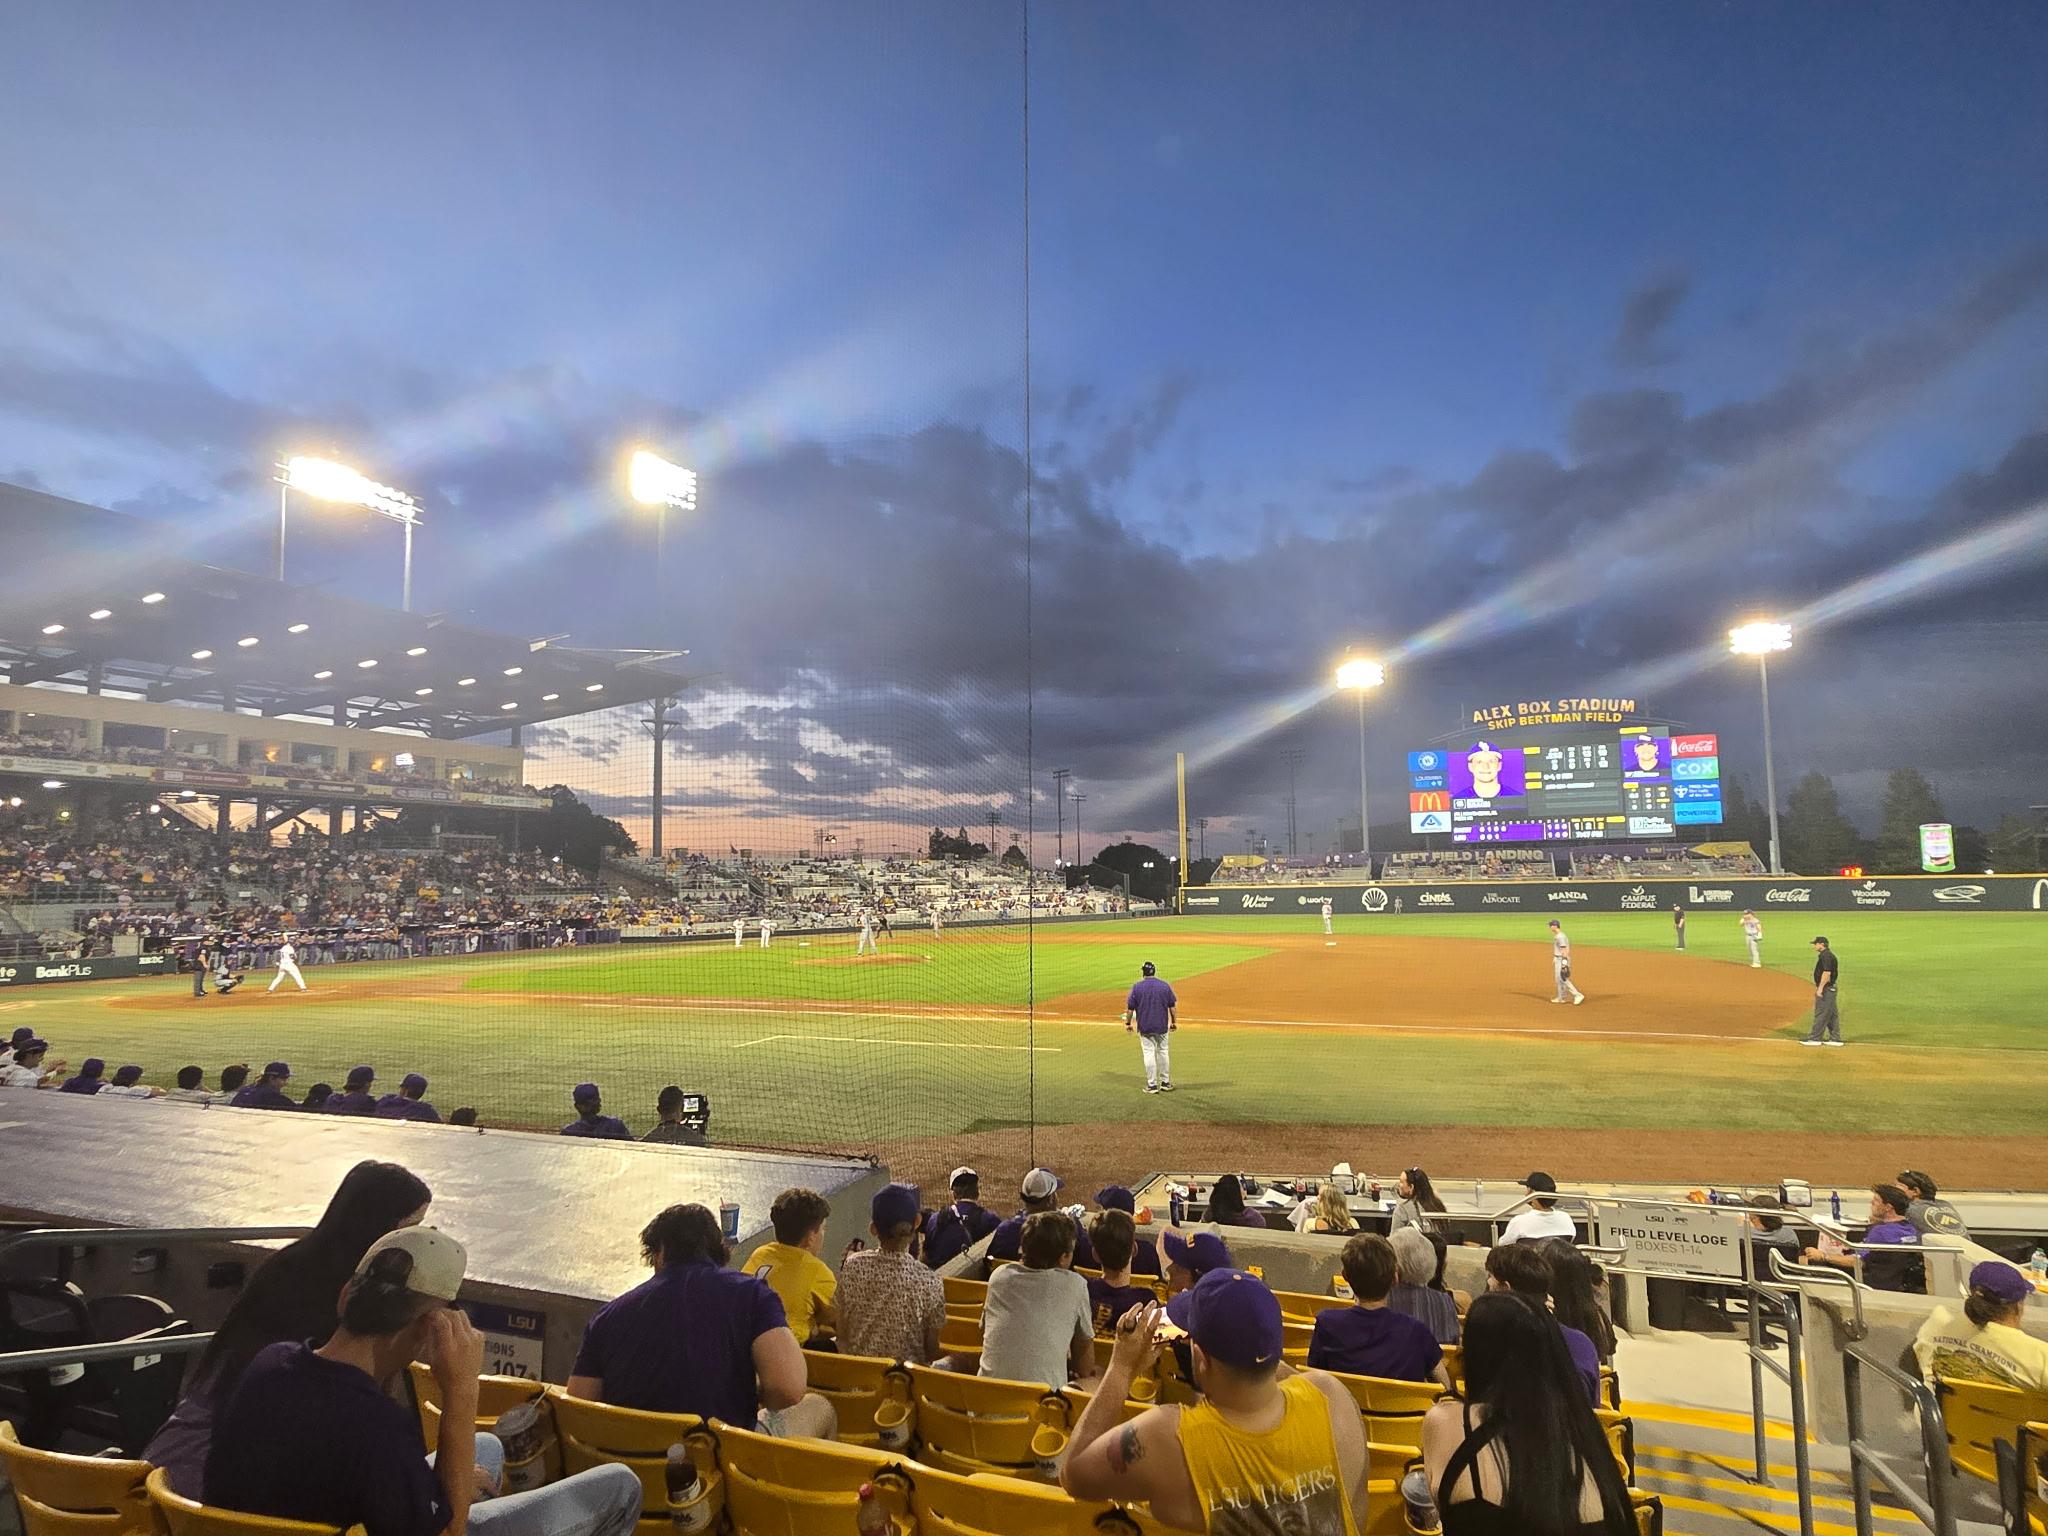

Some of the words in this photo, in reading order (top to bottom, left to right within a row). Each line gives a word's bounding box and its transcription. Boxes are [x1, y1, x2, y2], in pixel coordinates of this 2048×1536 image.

[1473, 705, 1512, 722] ALEX
[1518, 701, 1551, 714] BOX
[1558, 698, 1635, 712] STADIUM
[1488, 718, 1516, 730] SKIP
[1519, 713, 1580, 726] BERTMAN
[1585, 712, 1622, 723] FIELD
[1677, 763, 1713, 776] COX
[1392, 852, 1429, 863] LEFT
[1432, 851, 1472, 861] FIELD
[1475, 849, 1544, 861] LANDING
[1482, 896, 1520, 904] ADVOCATE
[1548, 890, 1588, 900] MANDA
[1621, 894, 1656, 902] CAMPUS
[1766, 888, 1811, 902] Coca-Cola
[1851, 889, 1891, 898] Woodside
[1621, 901, 1656, 909] FEDERAL
[1857, 897, 1886, 906] Energy
[36, 963, 92, 979] BankPlus
[1645, 1215, 1665, 1223] LSU
[1610, 1227, 1646, 1239] FIELD
[1650, 1229, 1690, 1243] LEVEL
[1693, 1233, 1729, 1246] LOGE
[1636, 1240, 1678, 1254] BOXES
[1680, 1243, 1703, 1256] 1-14
[508, 1313, 537, 1330] LSU
[1932, 1335, 1967, 1348] NATIONAL
[1969, 1341, 2018, 1373] CHAMPIONS
[493, 1359, 528, 1379] 107
[1209, 1487, 1251, 1512] LSU
